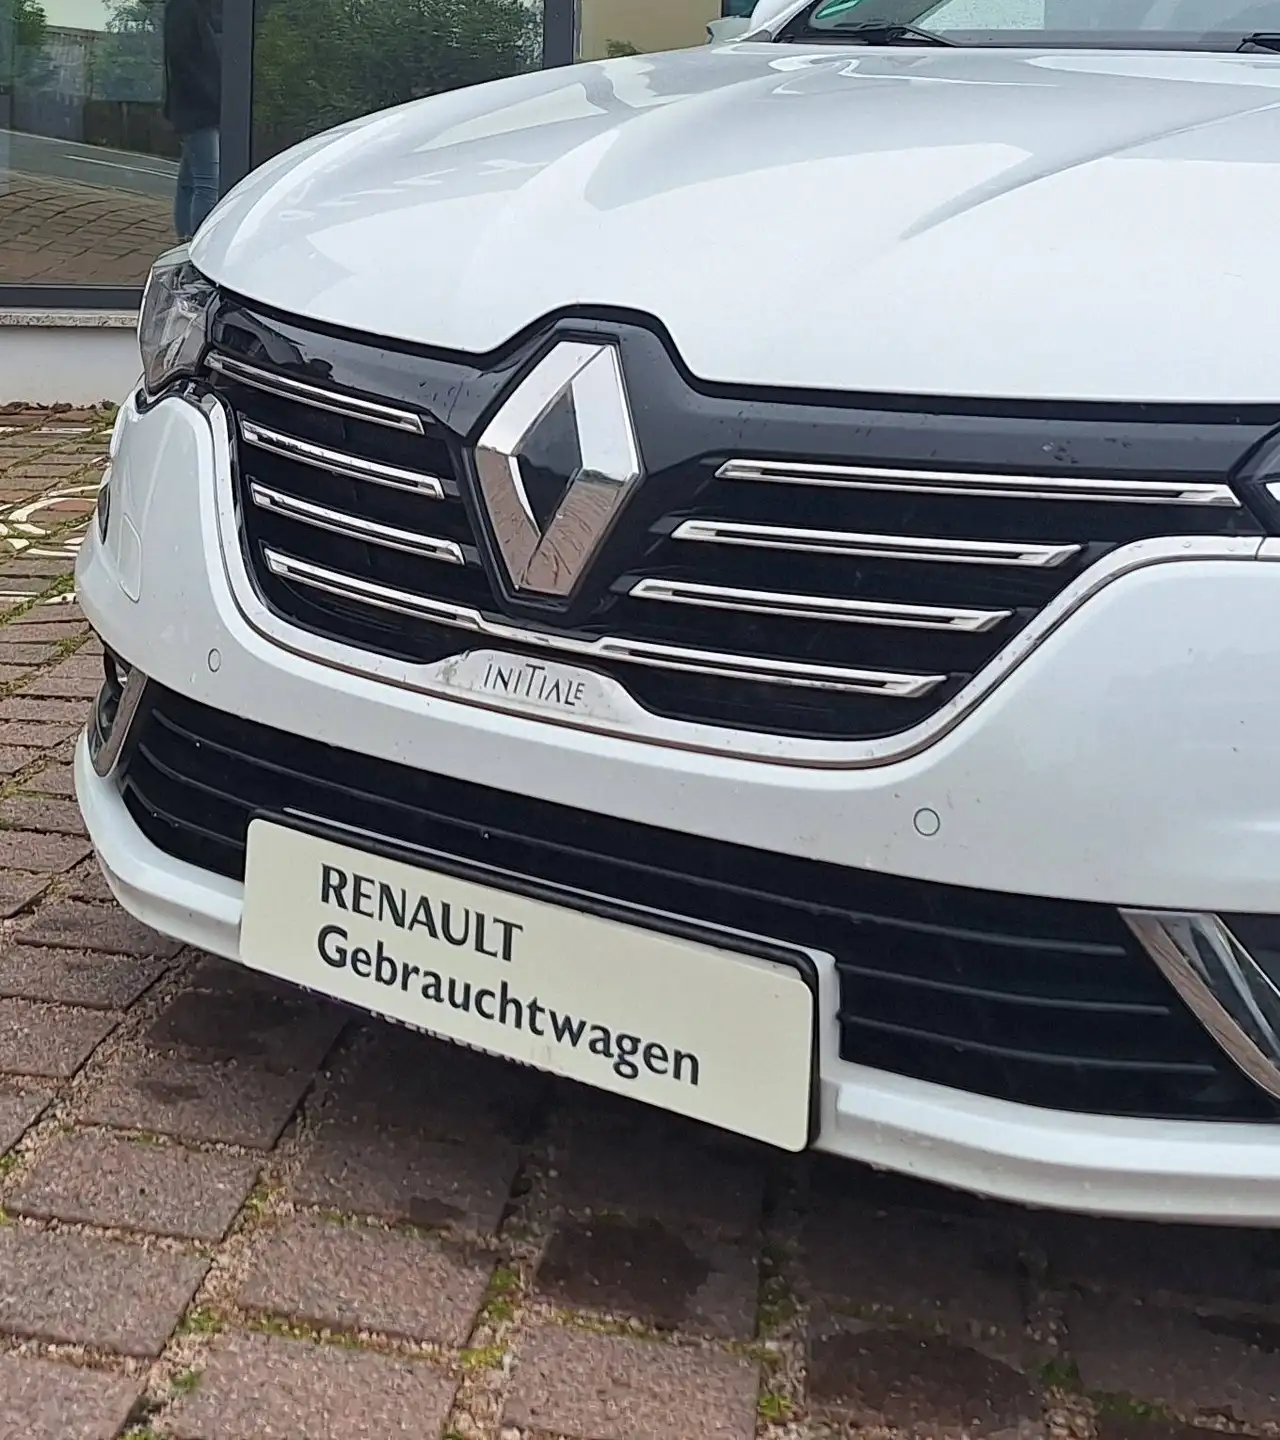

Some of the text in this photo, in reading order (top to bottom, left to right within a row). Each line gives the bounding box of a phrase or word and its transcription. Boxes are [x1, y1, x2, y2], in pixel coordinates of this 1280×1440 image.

[484, 663, 585, 706] INITIALE
[321, 863, 524, 961] RENAULT
[318, 924, 700, 1086] Gebrauchtwagen
